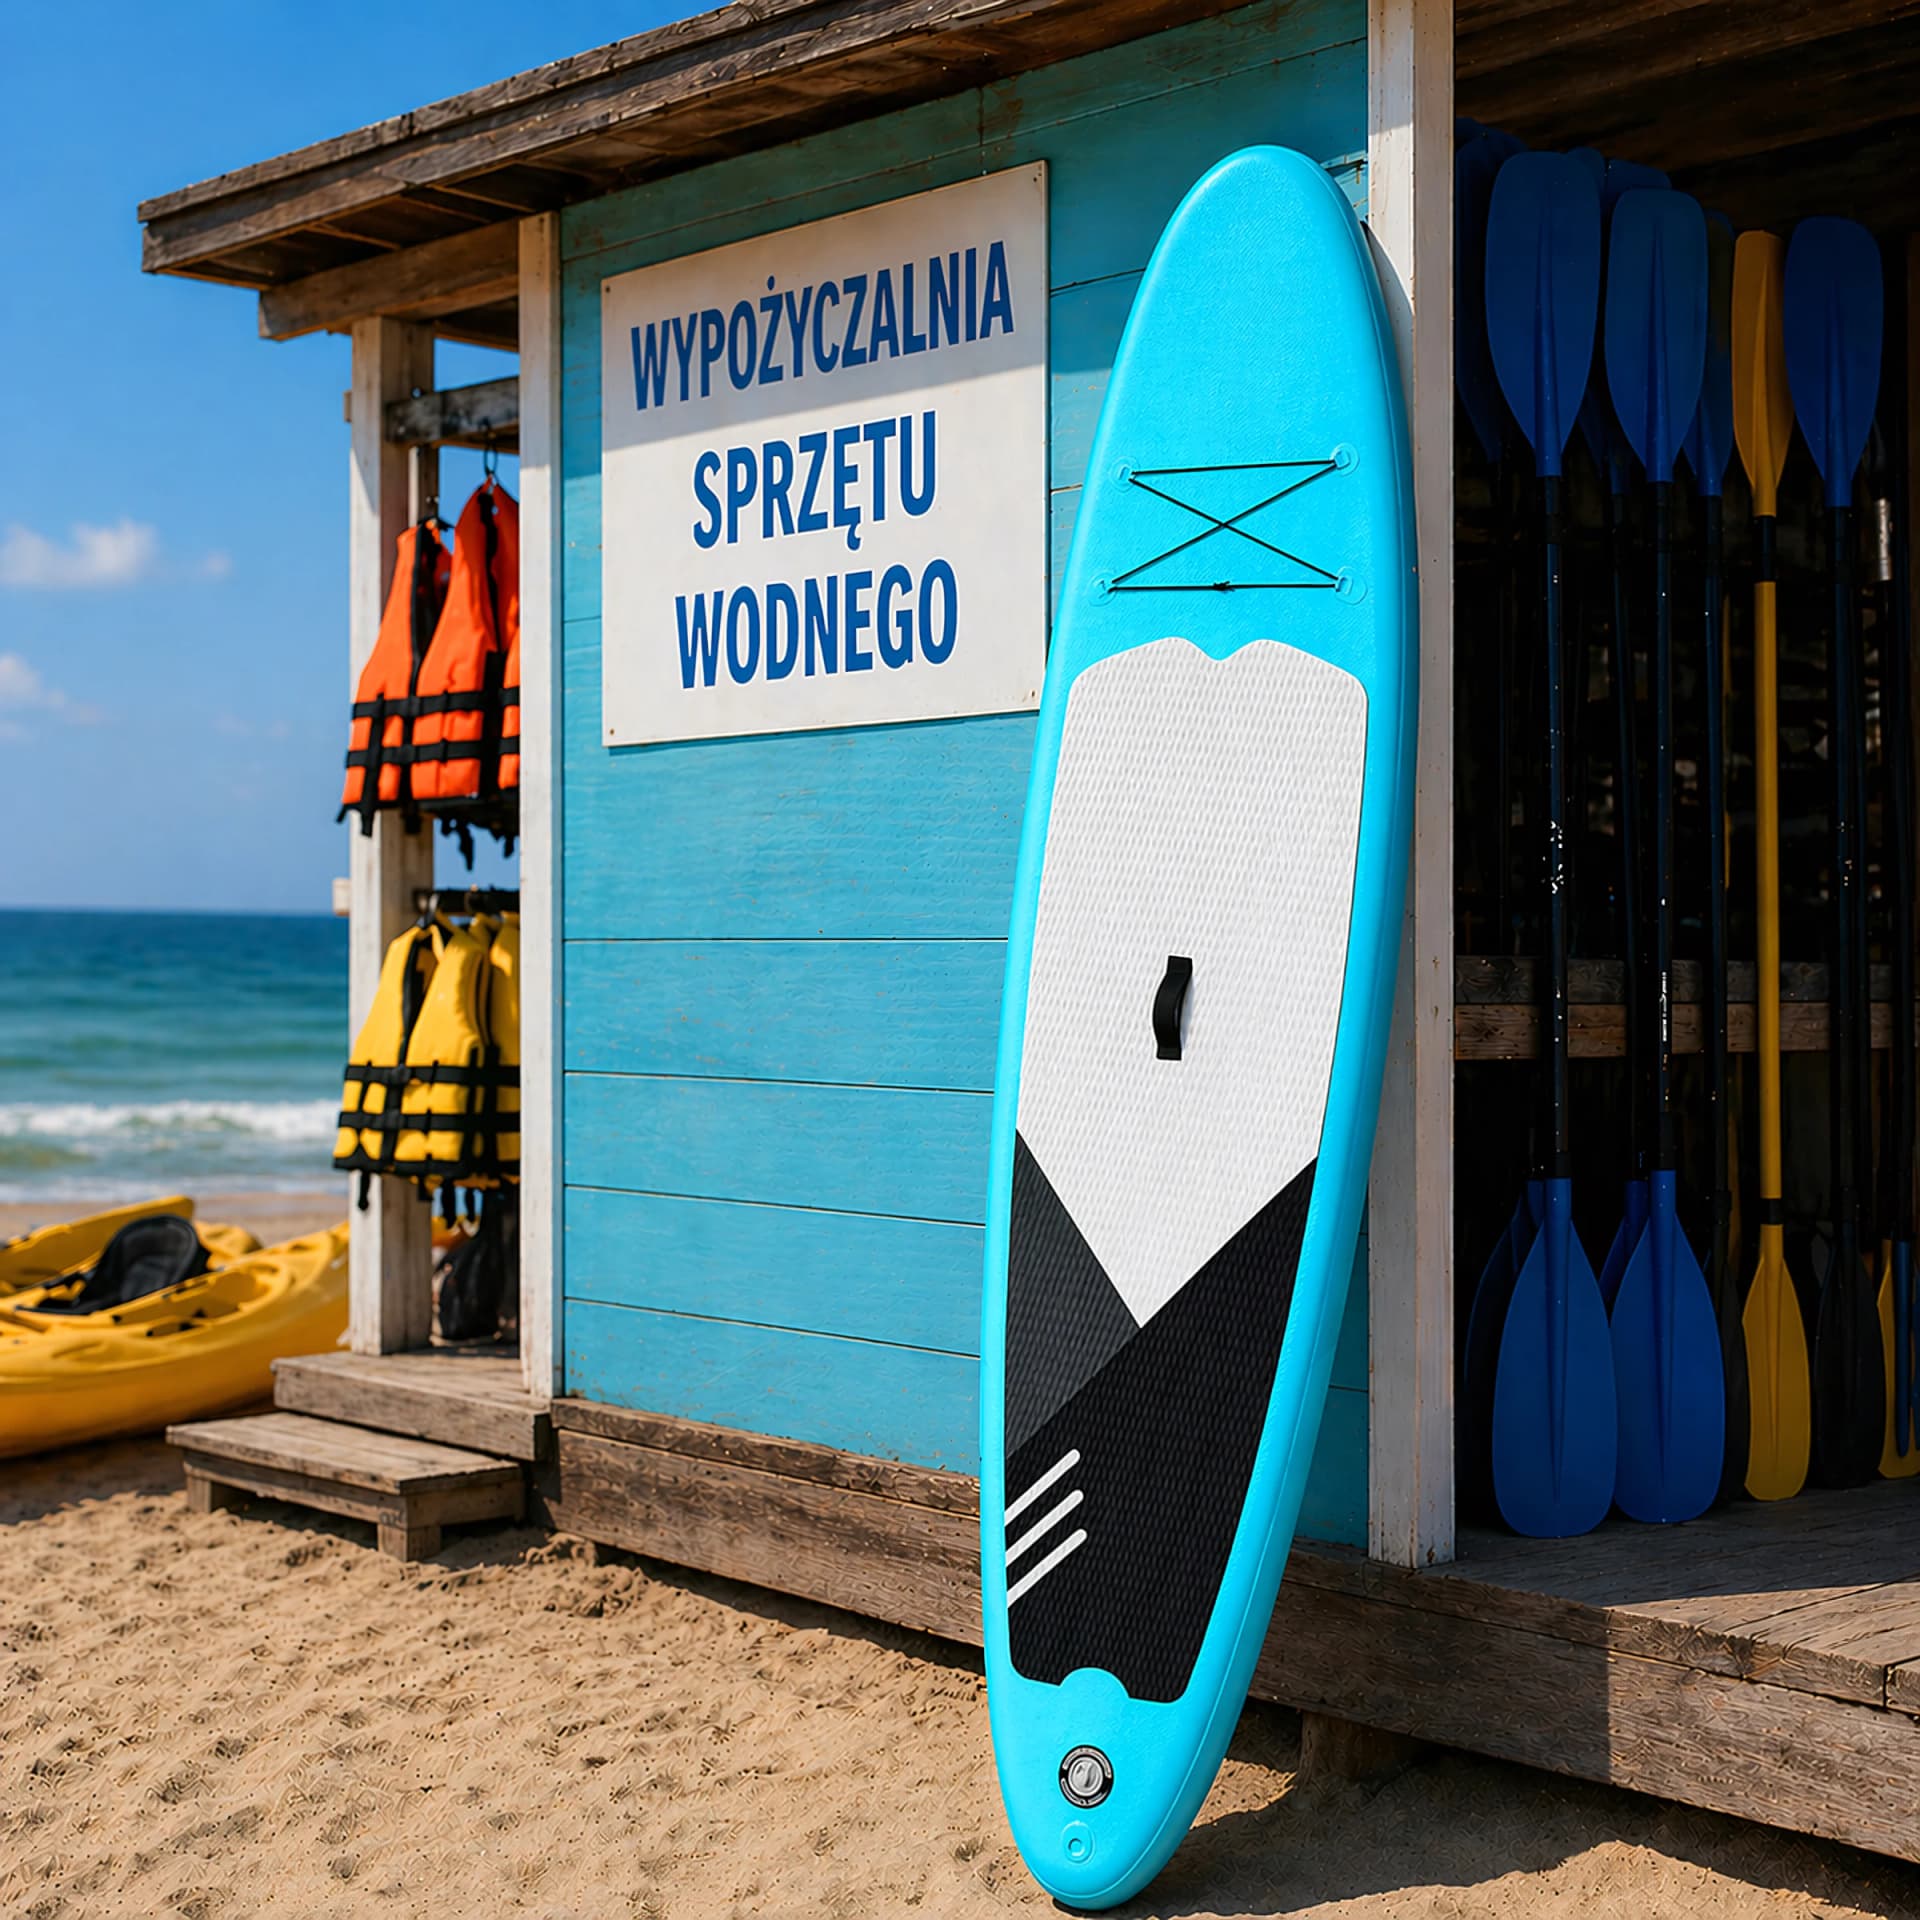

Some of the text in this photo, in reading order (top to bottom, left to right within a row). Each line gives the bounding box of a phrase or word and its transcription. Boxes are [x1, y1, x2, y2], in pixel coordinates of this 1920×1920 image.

[630, 240, 1015, 411] WYPOŻYCZALNIA
[692, 410, 937, 551] SPRZĘTU
[674, 558, 958, 689] WODNEGO
